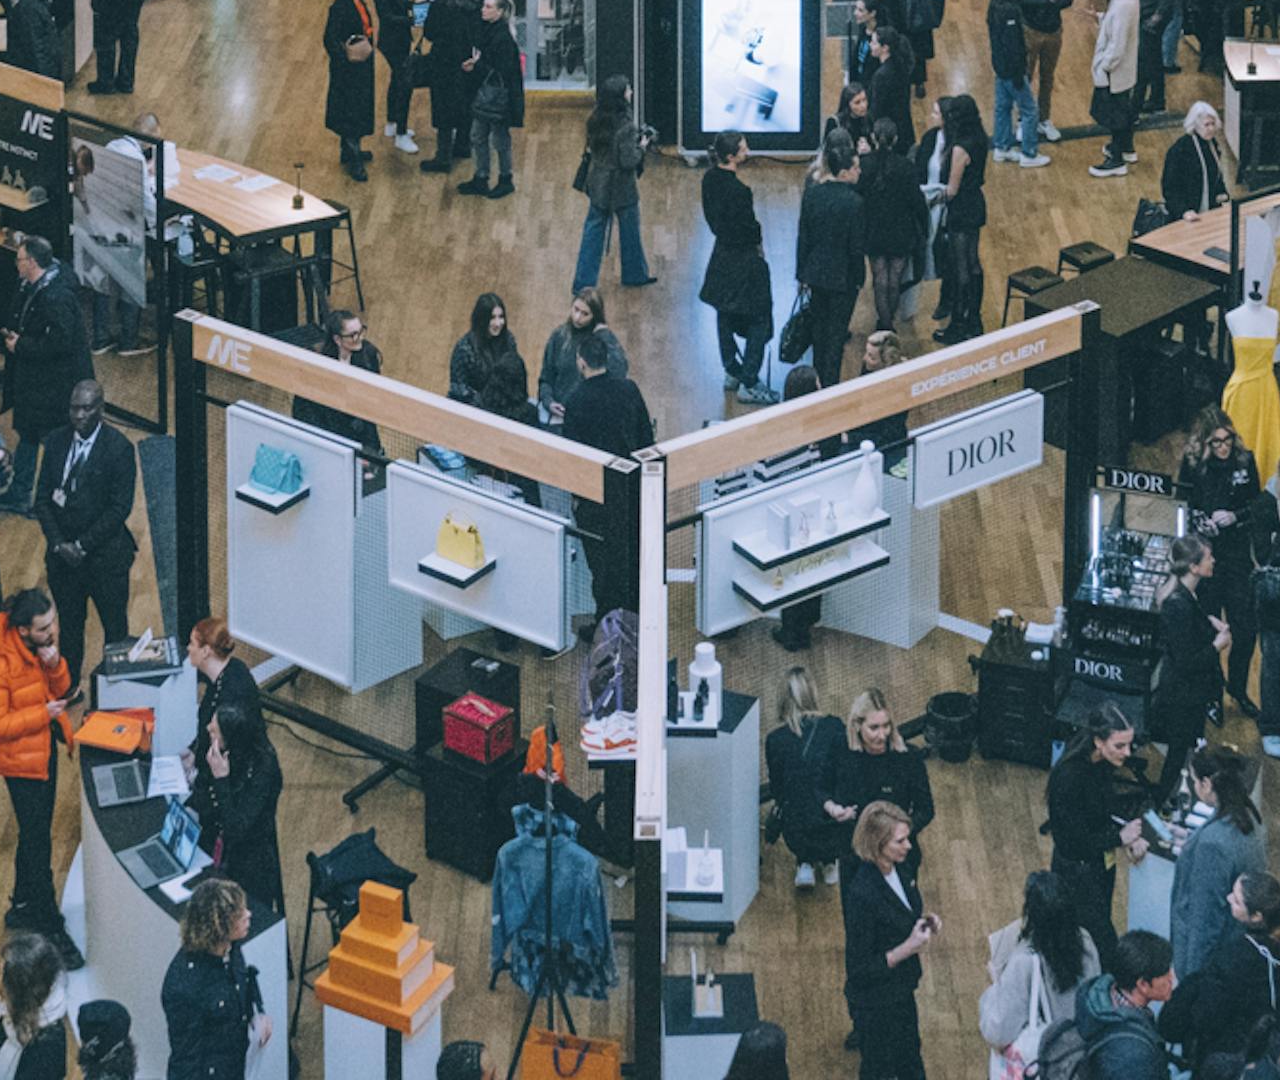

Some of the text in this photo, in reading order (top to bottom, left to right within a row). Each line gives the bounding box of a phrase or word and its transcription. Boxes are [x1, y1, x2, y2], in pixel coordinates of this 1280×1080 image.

[911, 338, 1046, 397] EXPÉRIENCE CLIENT
[947, 429, 1016, 477] DIOR
[1111, 469, 1165, 494] DIOR
[1074, 657, 1123, 682] DIOR
